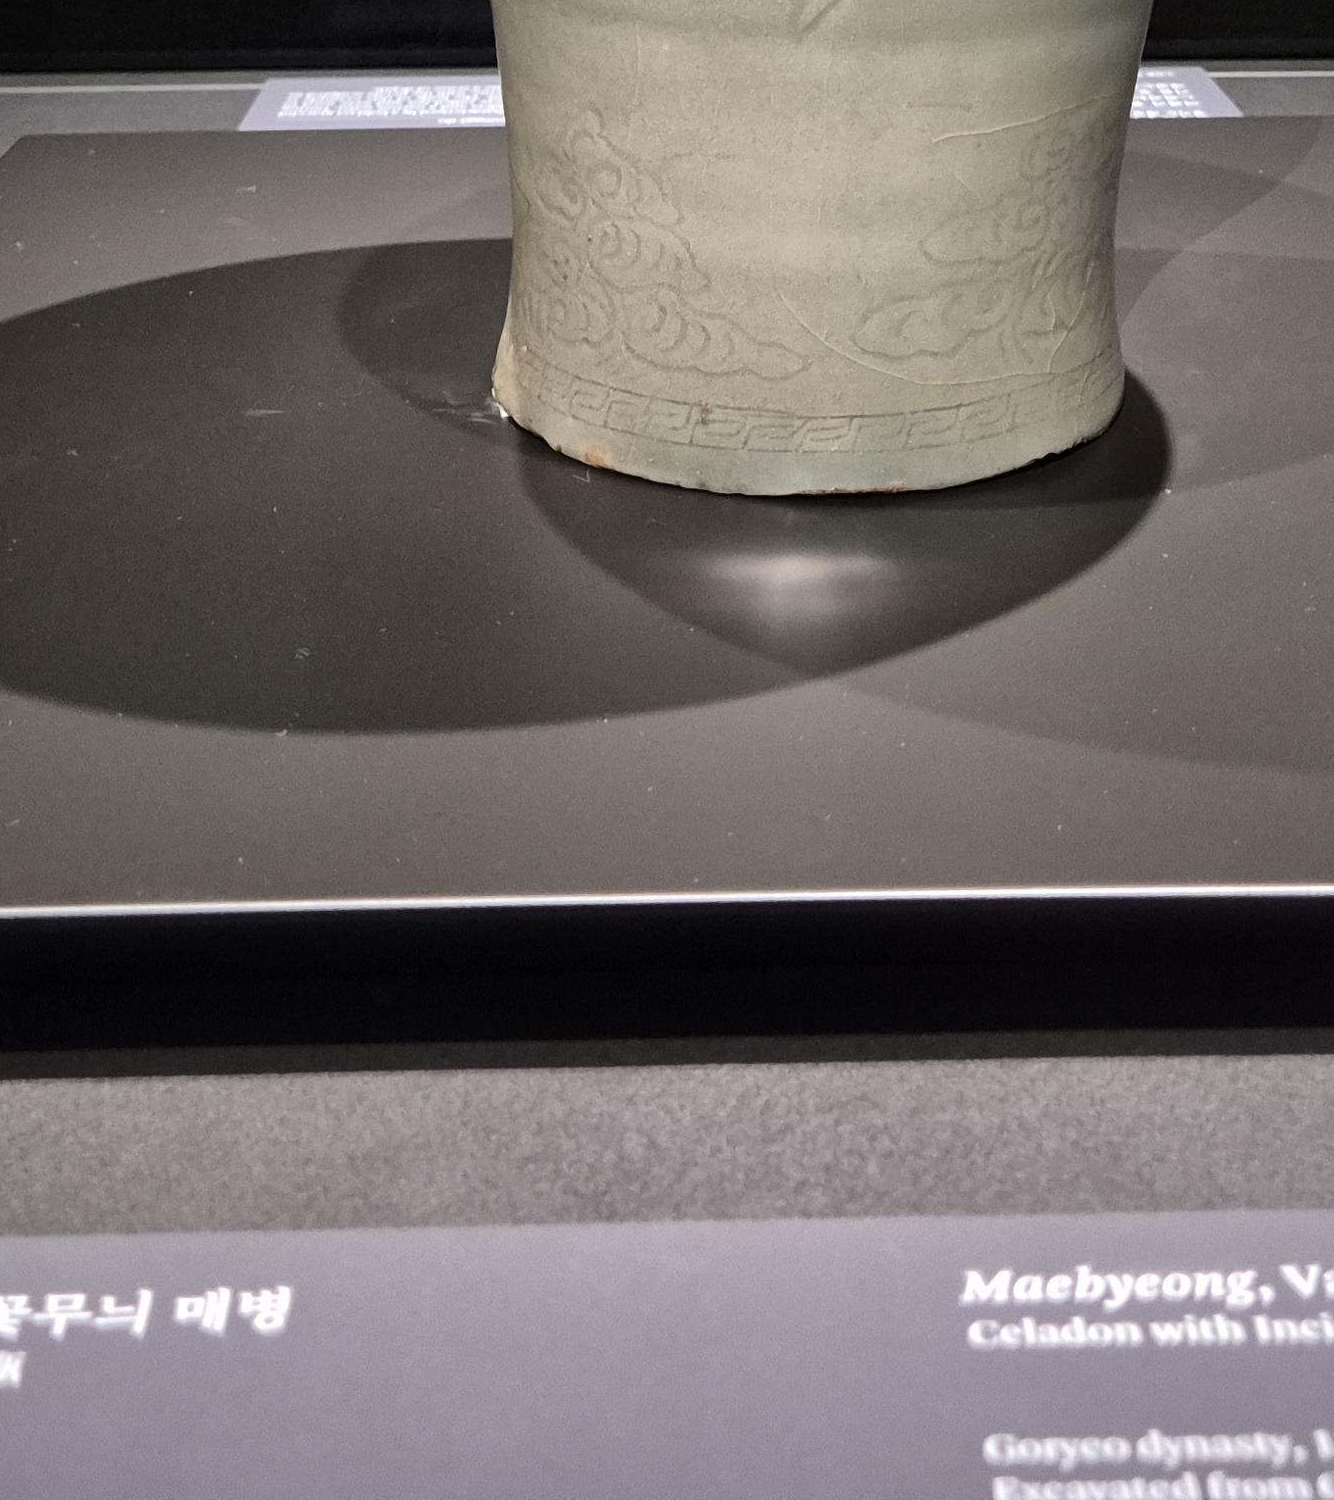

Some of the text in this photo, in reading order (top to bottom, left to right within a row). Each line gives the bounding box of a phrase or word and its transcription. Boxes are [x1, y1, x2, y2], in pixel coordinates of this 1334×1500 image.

[172, 1283, 294, 1337] 매병
[959, 1263, 1276, 1313] Maebyeong,
[967, 1315, 1144, 1349] Celadon
[1149, 1313, 1246, 1345] with
[983, 1433, 1132, 1471] Goryeo
[1136, 1429, 1308, 1468] dynasty,
